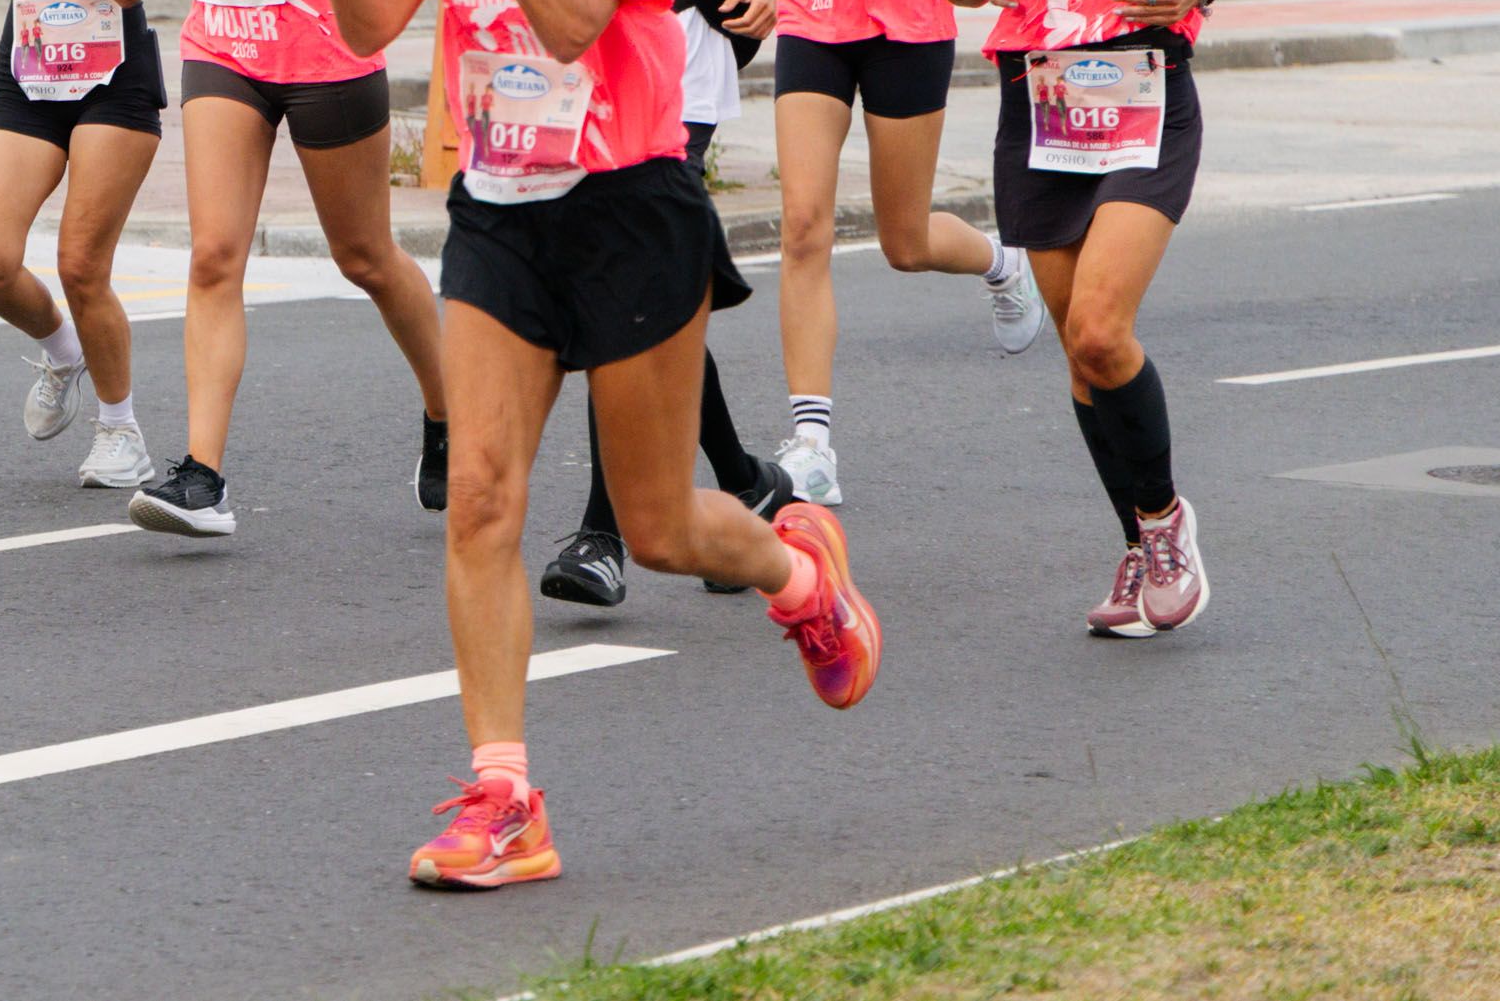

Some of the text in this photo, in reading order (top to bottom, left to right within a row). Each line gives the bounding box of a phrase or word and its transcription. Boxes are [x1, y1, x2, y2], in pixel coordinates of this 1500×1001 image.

[42, 11, 84, 22] ASTURIANA
[204, 3, 279, 41] MUJER
[44, 43, 86, 62] 016
[231, 41, 259, 59] 2026
[1069, 69, 1119, 80] ASTURIANA
[1069, 107, 1120, 128] 016
[490, 123, 537, 151] 016
[1046, 152, 1086, 165] OYSHO
